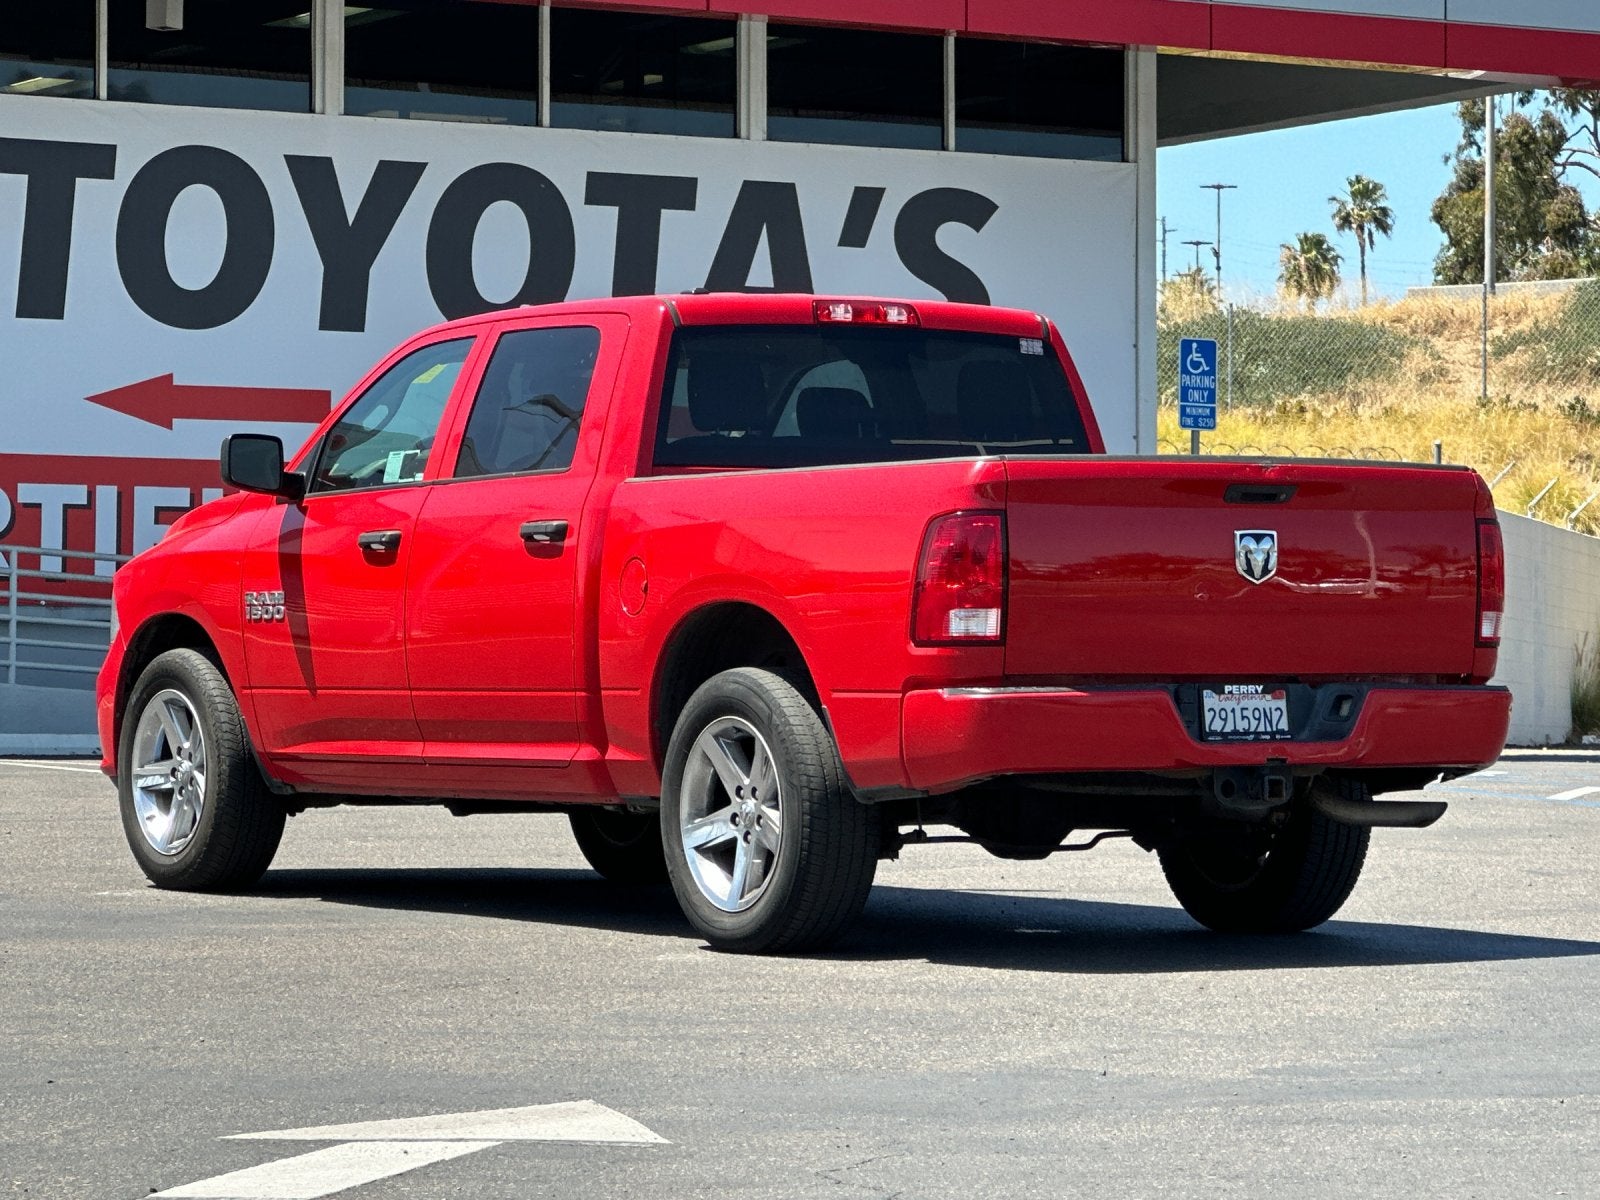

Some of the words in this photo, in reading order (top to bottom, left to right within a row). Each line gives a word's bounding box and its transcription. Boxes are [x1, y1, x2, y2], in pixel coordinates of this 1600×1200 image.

[0, 137, 999, 332] TOYOTA'S
[1181, 374, 1215, 389] PARKING
[1187, 389, 1209, 402] ONLY
[1185, 406, 1210, 416] MINIMUM
[1181, 417, 1194, 426] FINE
[1198, 417, 1215, 428] $250
[0, 483, 224, 578] TIF
[244, 591, 285, 605] RAM
[244, 605, 286, 620] 1500
[1224, 685, 1264, 694] PERRY
[1207, 706, 1284, 732] 29159N2
